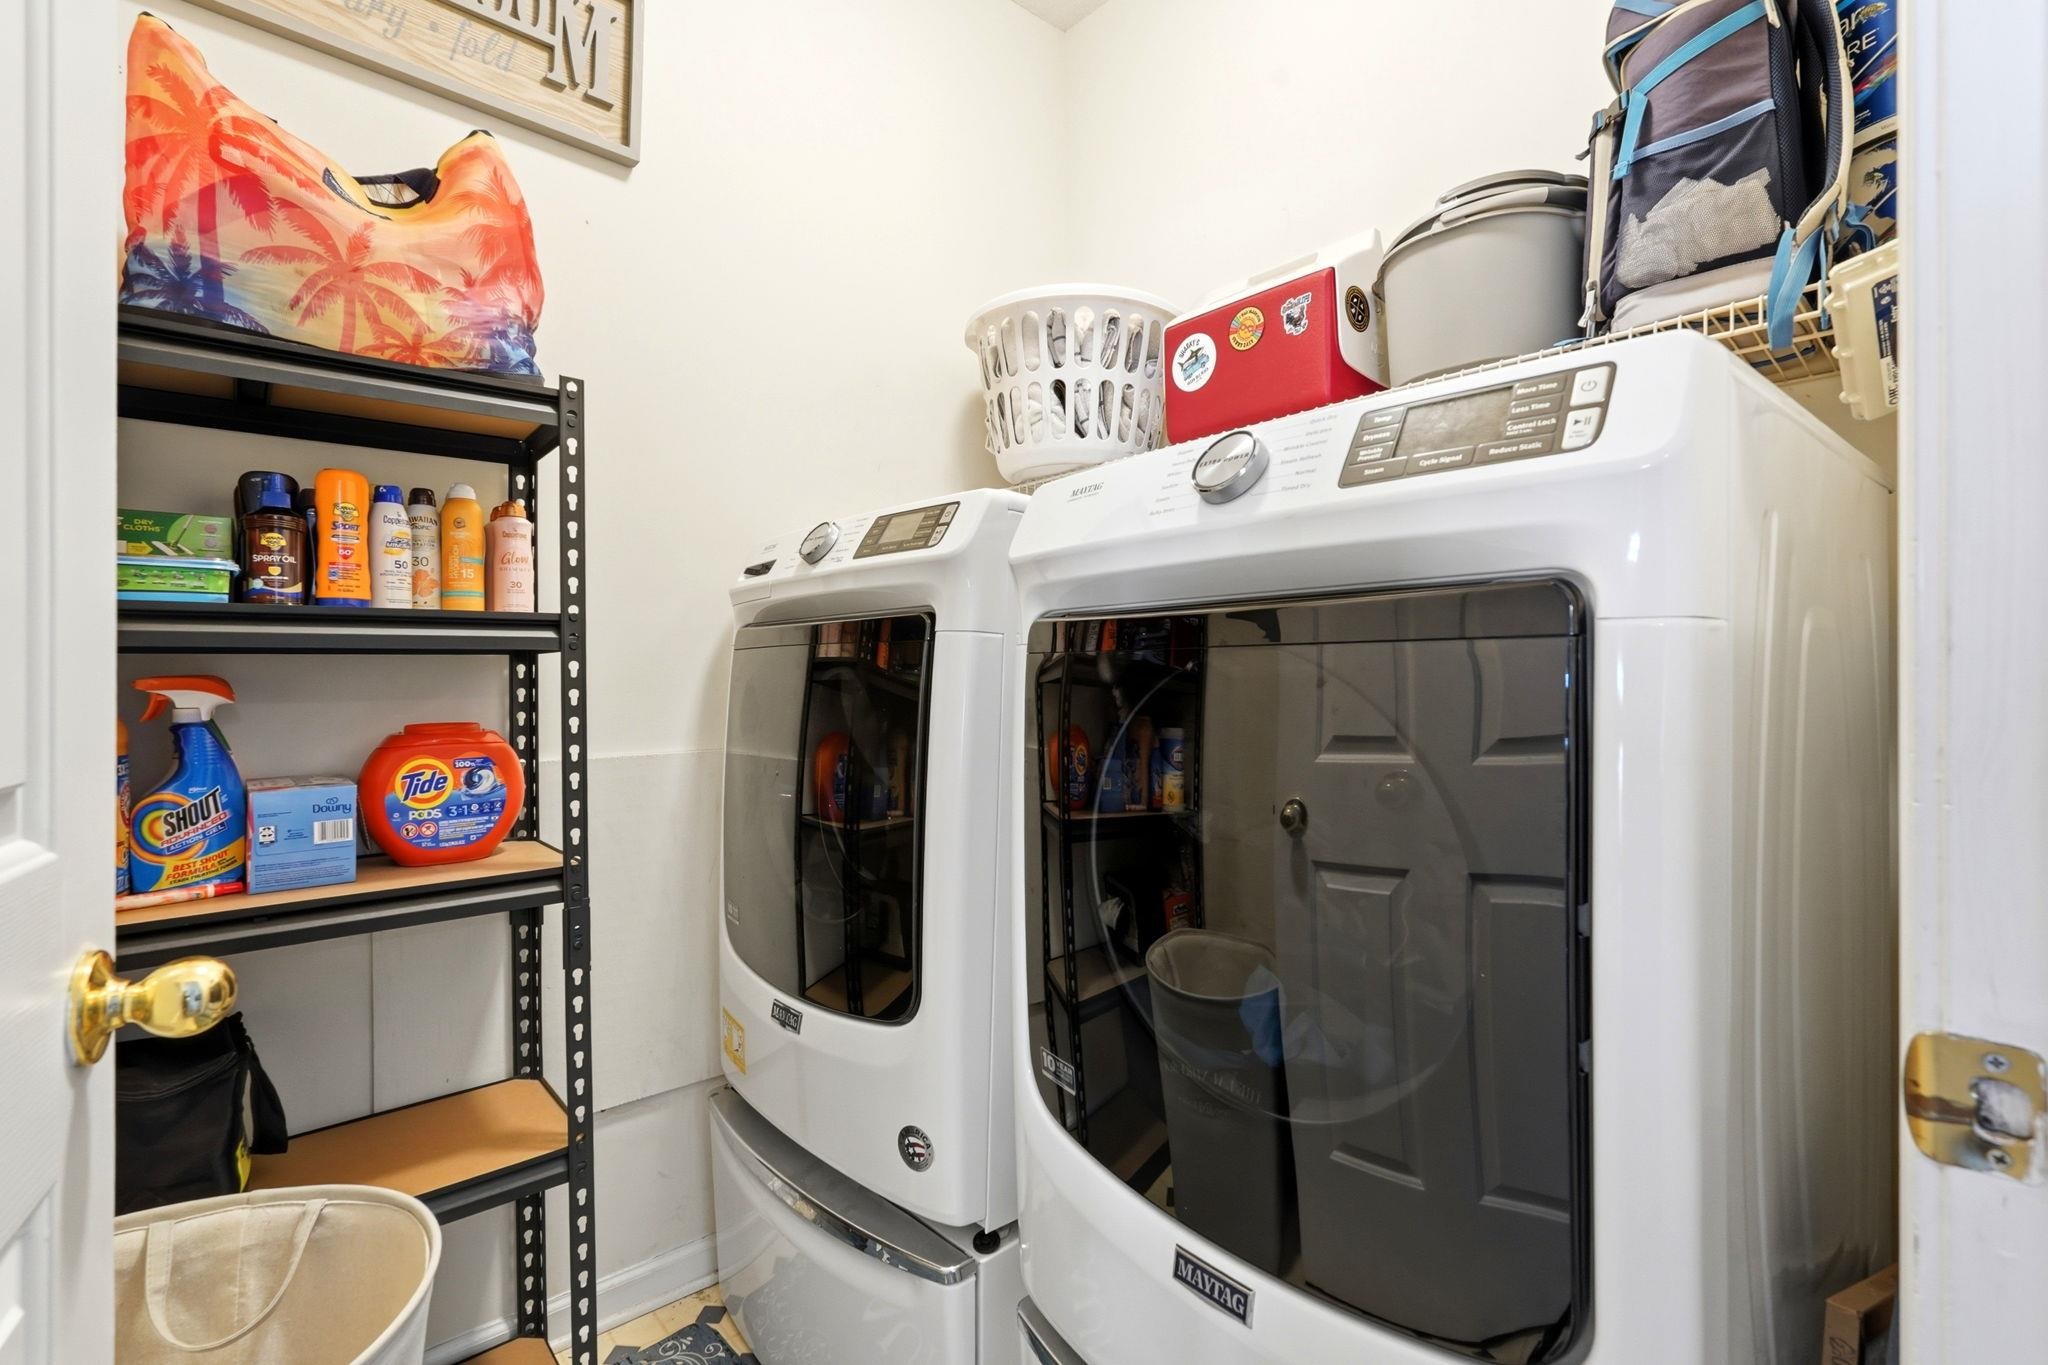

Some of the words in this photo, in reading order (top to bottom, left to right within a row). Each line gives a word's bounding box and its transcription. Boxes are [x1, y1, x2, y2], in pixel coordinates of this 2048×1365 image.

[449, 18, 520, 72] fold
[1516, 386, 1537, 395] More
[1538, 382, 1558, 391] Time
[1511, 406, 1530, 414] Less
[1531, 402, 1551, 411] Time
[1507, 422, 1537, 431] Control
[1537, 417, 1557, 426] Lock
[1488, 445, 1518, 456] Reduce
[1519, 441, 1543, 451] Static
[1419, 457, 1438, 467] Cycle
[1438, 453, 1463, 464] Signal
[123, 523, 161, 533] CLOTHS
[331, 520, 361, 532] SPORT
[408, 515, 438, 527] WAIIAN
[252, 554, 281, 563] SPRAY
[281, 554, 297, 564] OIL
[394, 560, 409, 570] 50
[412, 556, 429, 567] 30
[501, 551, 530, 566] Glow
[462, 568, 475, 579] 15
[510, 581, 523, 589] 30
[401, 770, 449, 802] Tide
[163, 786, 221, 838] SHOUT
[312, 803, 352, 814] Downy
[408, 808, 442, 820] PODS
[161, 811, 229, 847] ADVANCED
[168, 834, 204, 852] ACTION
[205, 824, 226, 837] GEL
[172, 860, 198, 872] BEST
[198, 850, 229, 865] SHOUT
[166, 862, 217, 881] FORMULA
[1042, 1050, 1056, 1073] 10
[1176, 1256, 1246, 1316] MAYTAG
